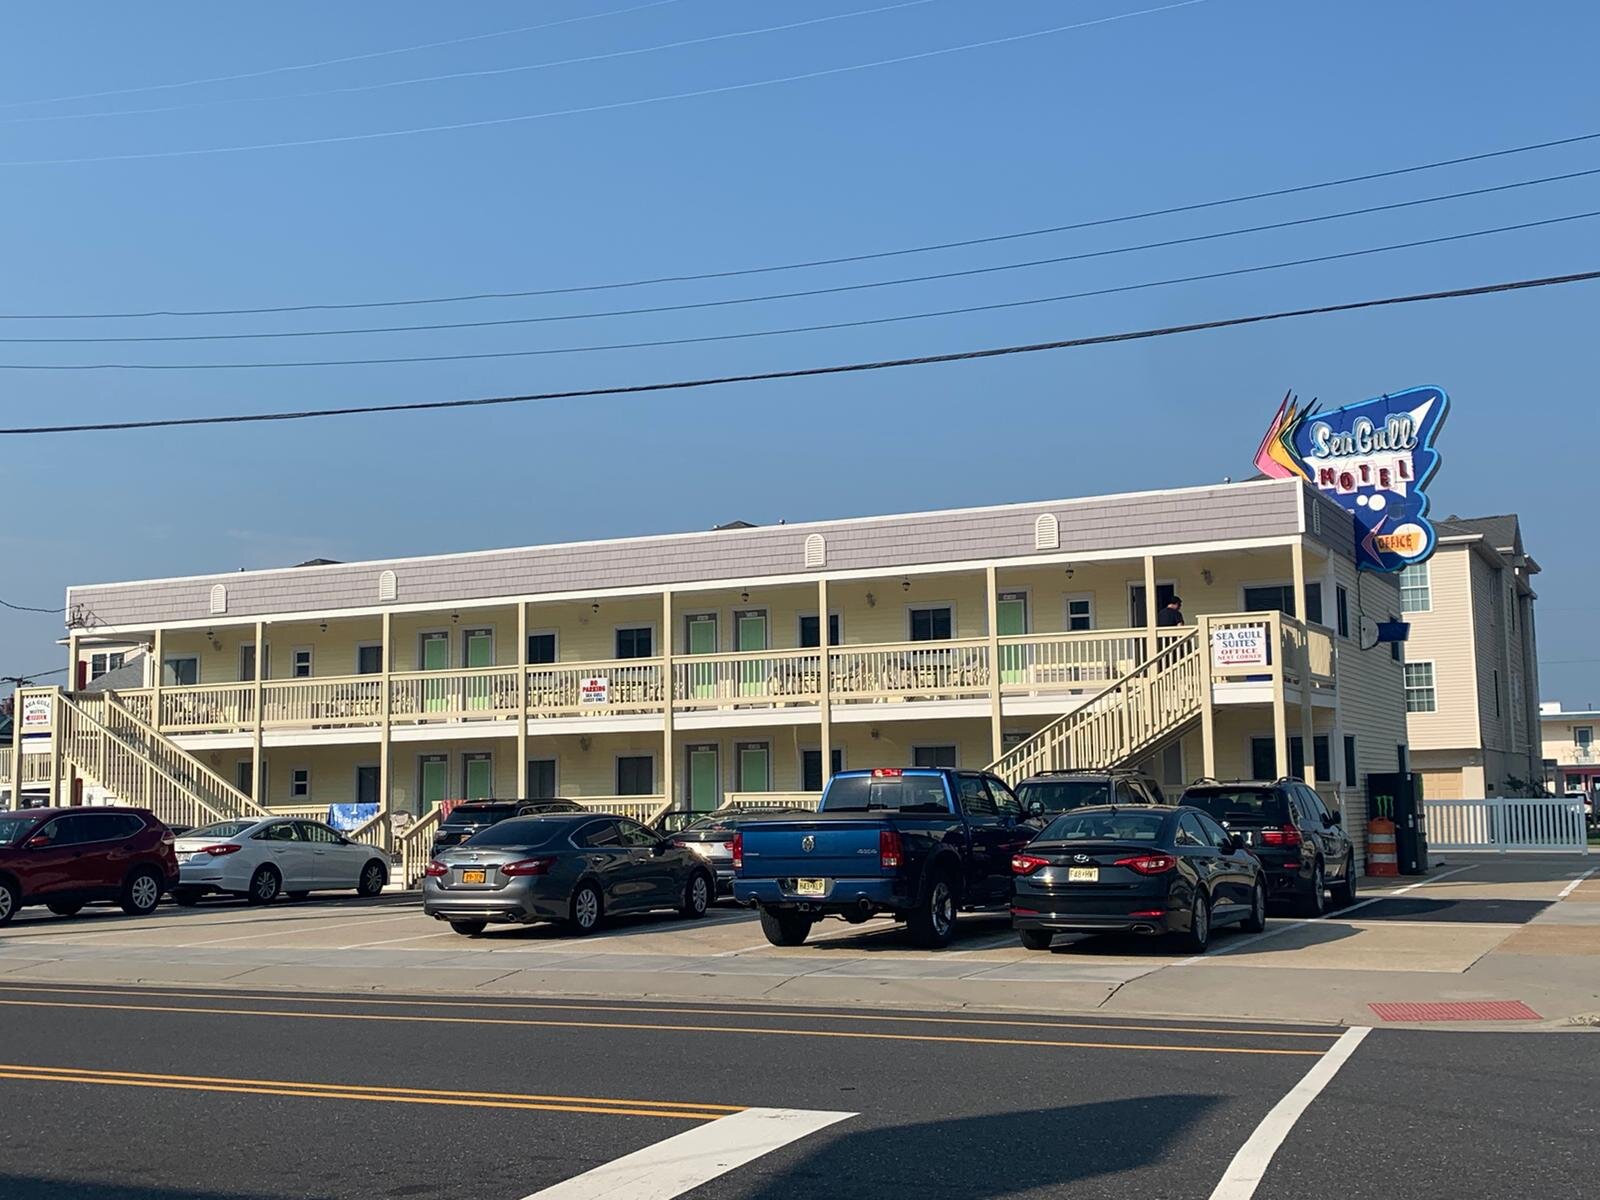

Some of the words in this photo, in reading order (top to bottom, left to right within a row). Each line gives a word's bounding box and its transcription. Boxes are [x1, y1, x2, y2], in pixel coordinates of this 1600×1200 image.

[1320, 459, 1408, 490] MOTEL
[1378, 534, 1412, 549] OFFICE
[1216, 632, 1234, 640] SEA
[1238, 631, 1262, 639] GULL
[1222, 640, 1256, 648] SUITES
[36, 699, 50, 708] GULL
